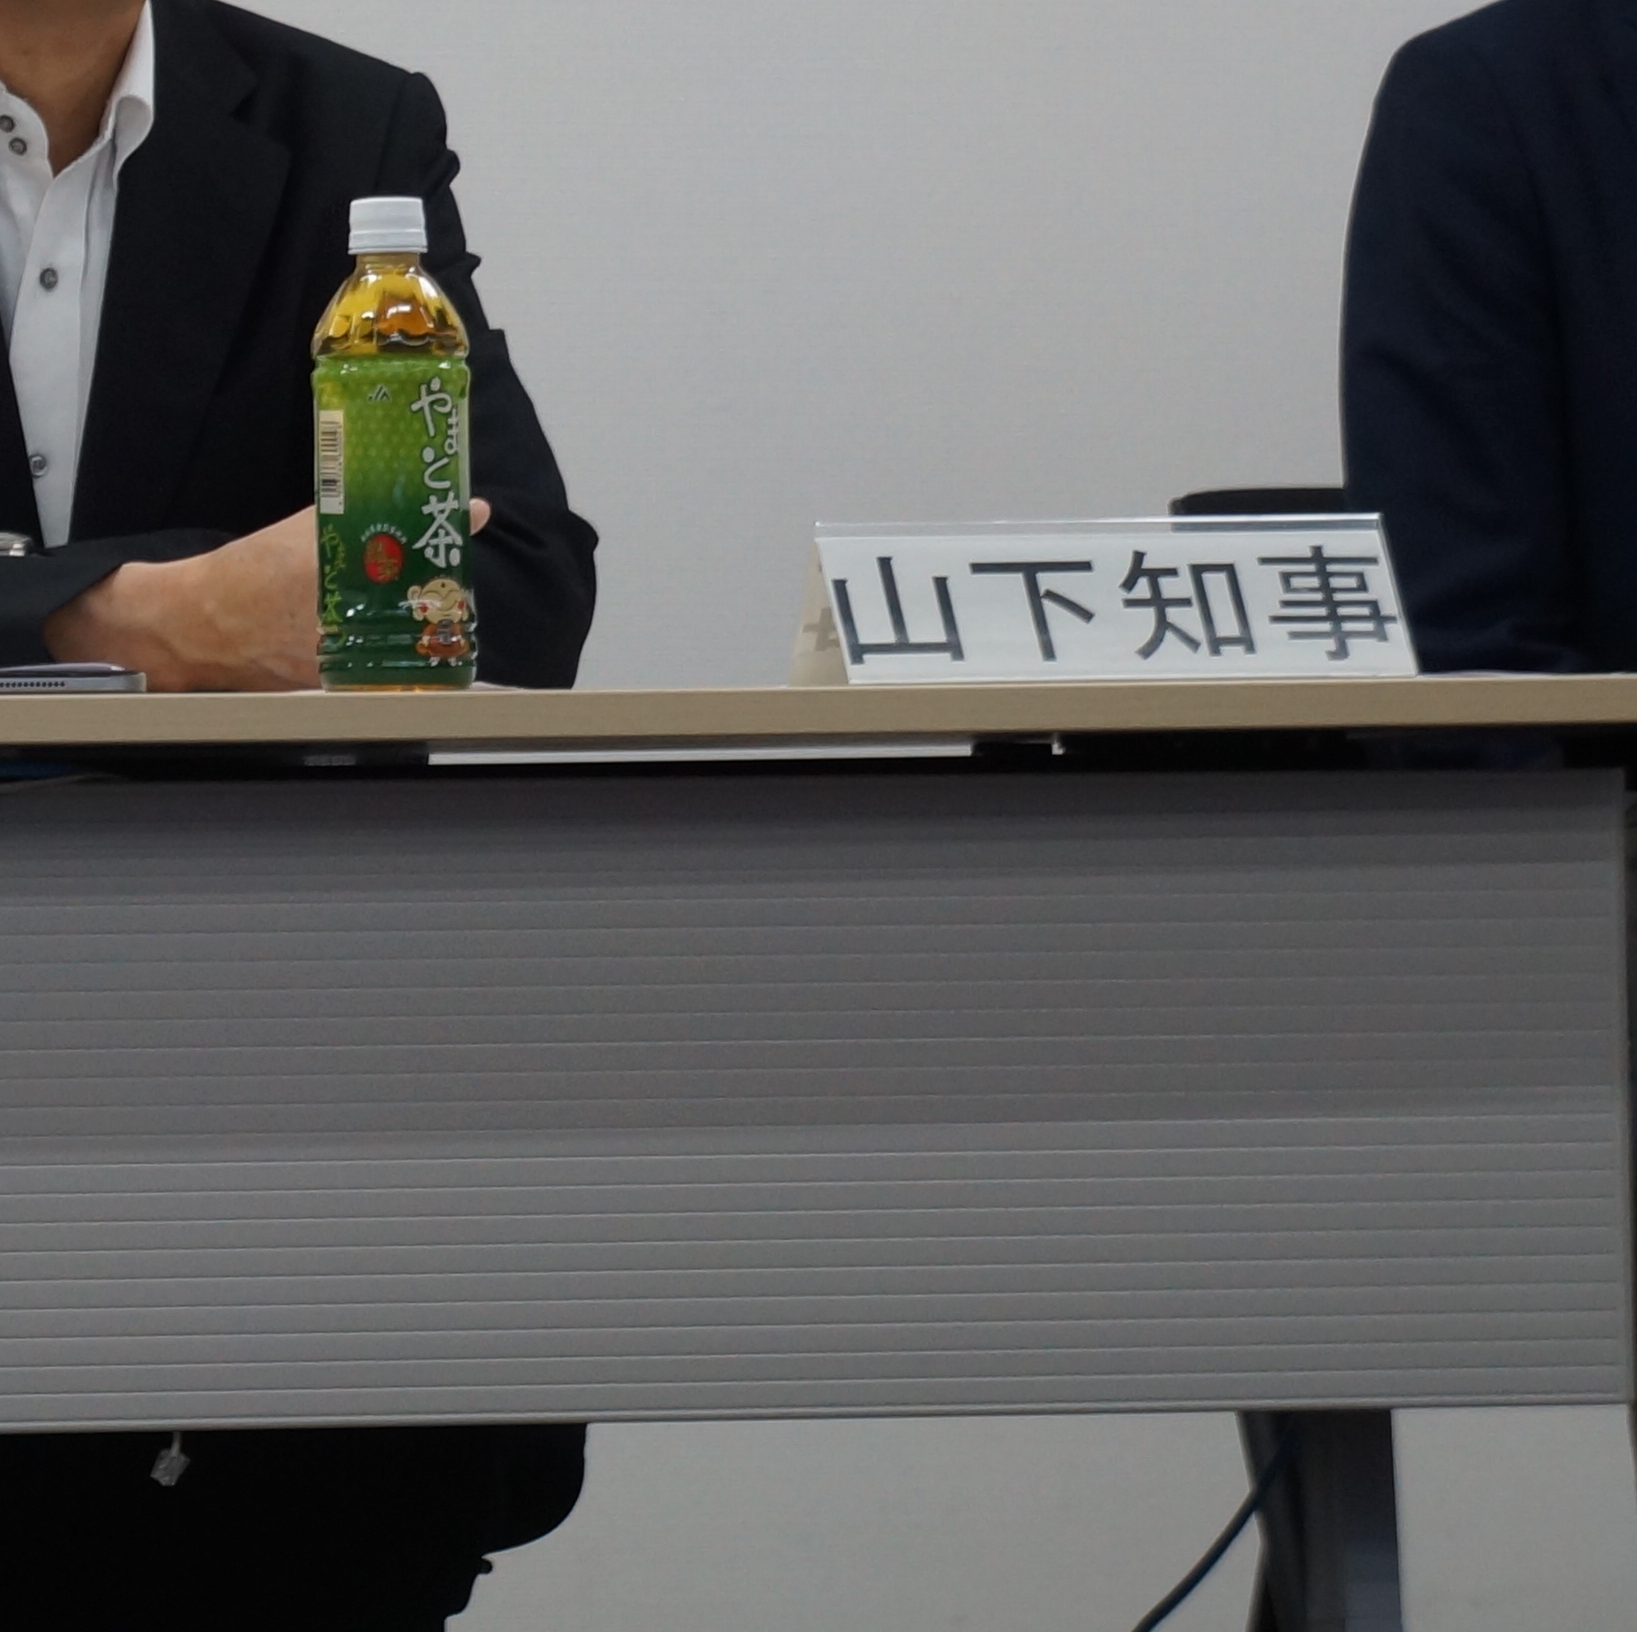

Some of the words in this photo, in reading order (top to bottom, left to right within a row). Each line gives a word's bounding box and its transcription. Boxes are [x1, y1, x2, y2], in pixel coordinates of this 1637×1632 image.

[410, 376, 463, 569] やまと茶
[831, 544, 1398, 664] 山下知事
